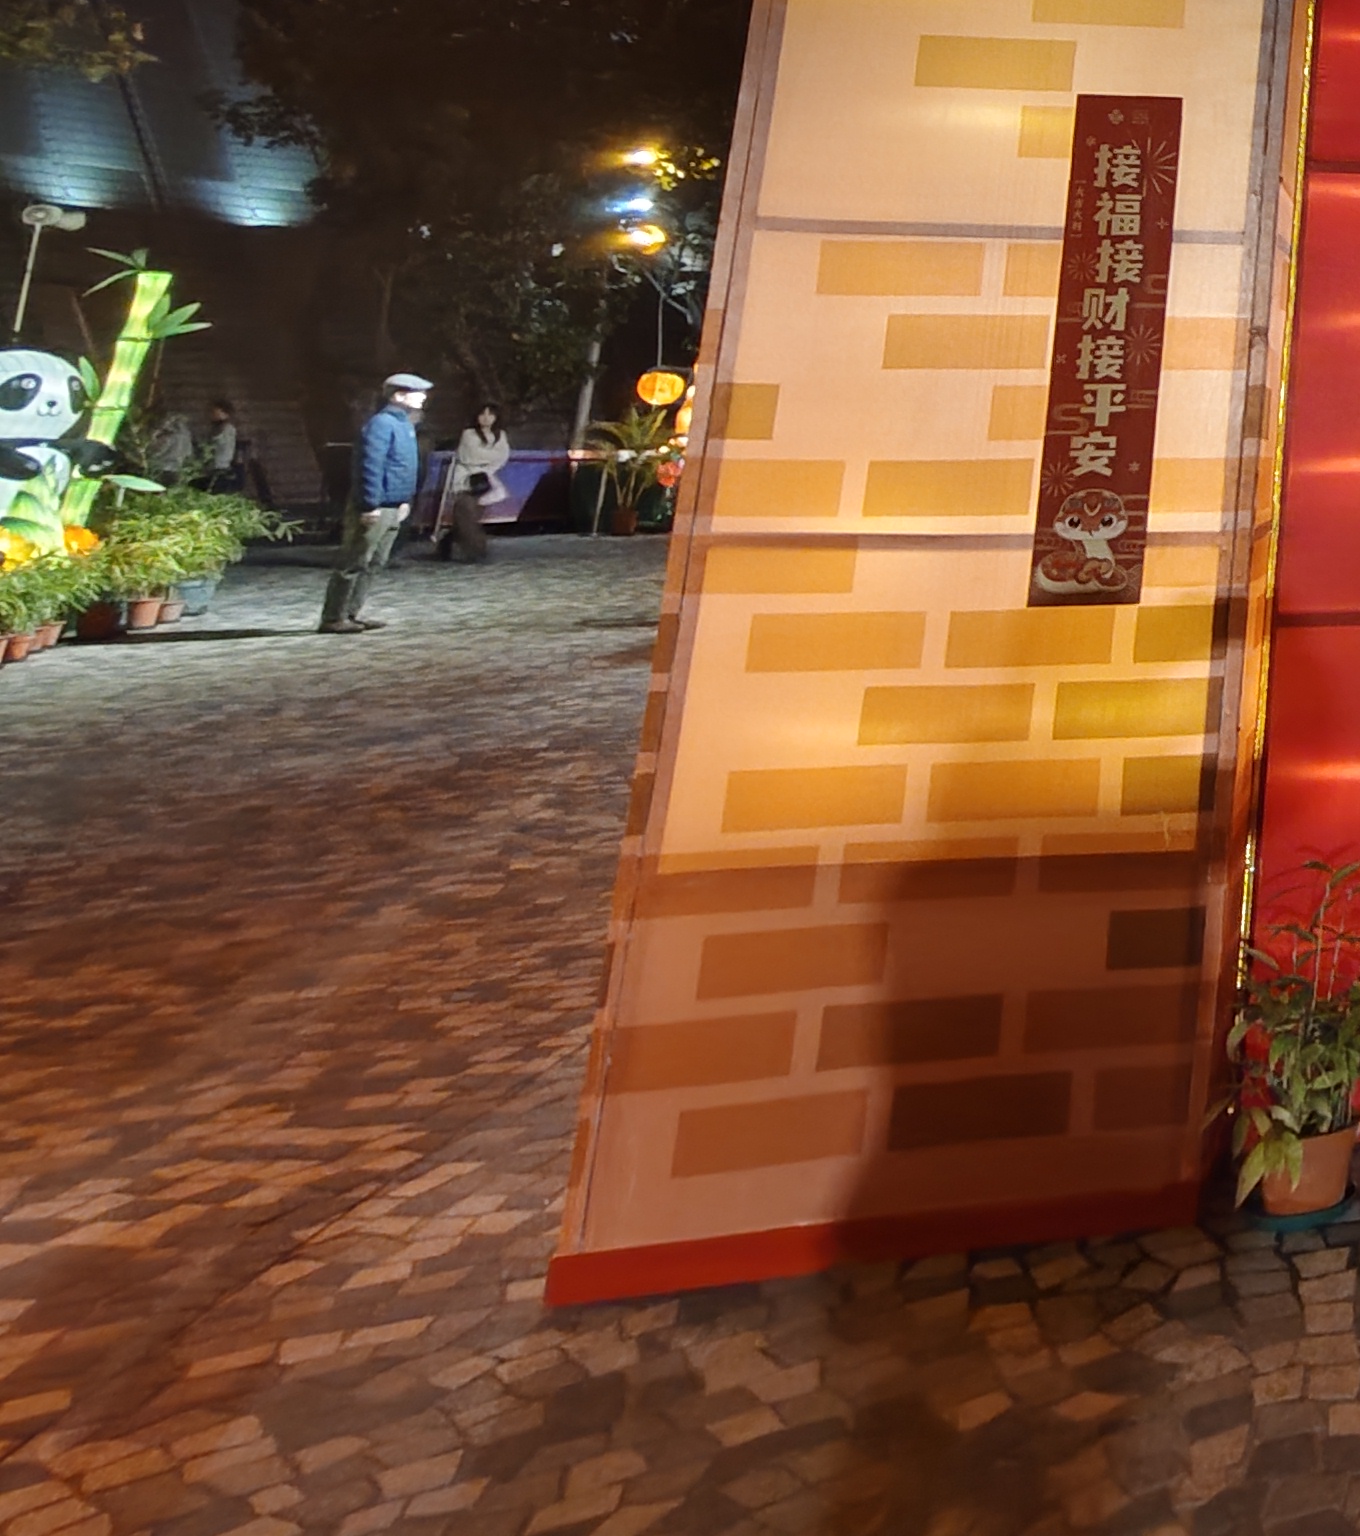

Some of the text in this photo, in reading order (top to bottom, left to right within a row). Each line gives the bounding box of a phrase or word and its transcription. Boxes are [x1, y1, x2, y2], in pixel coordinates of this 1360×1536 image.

[1069, 144, 1143, 478] 接福接财接平安
